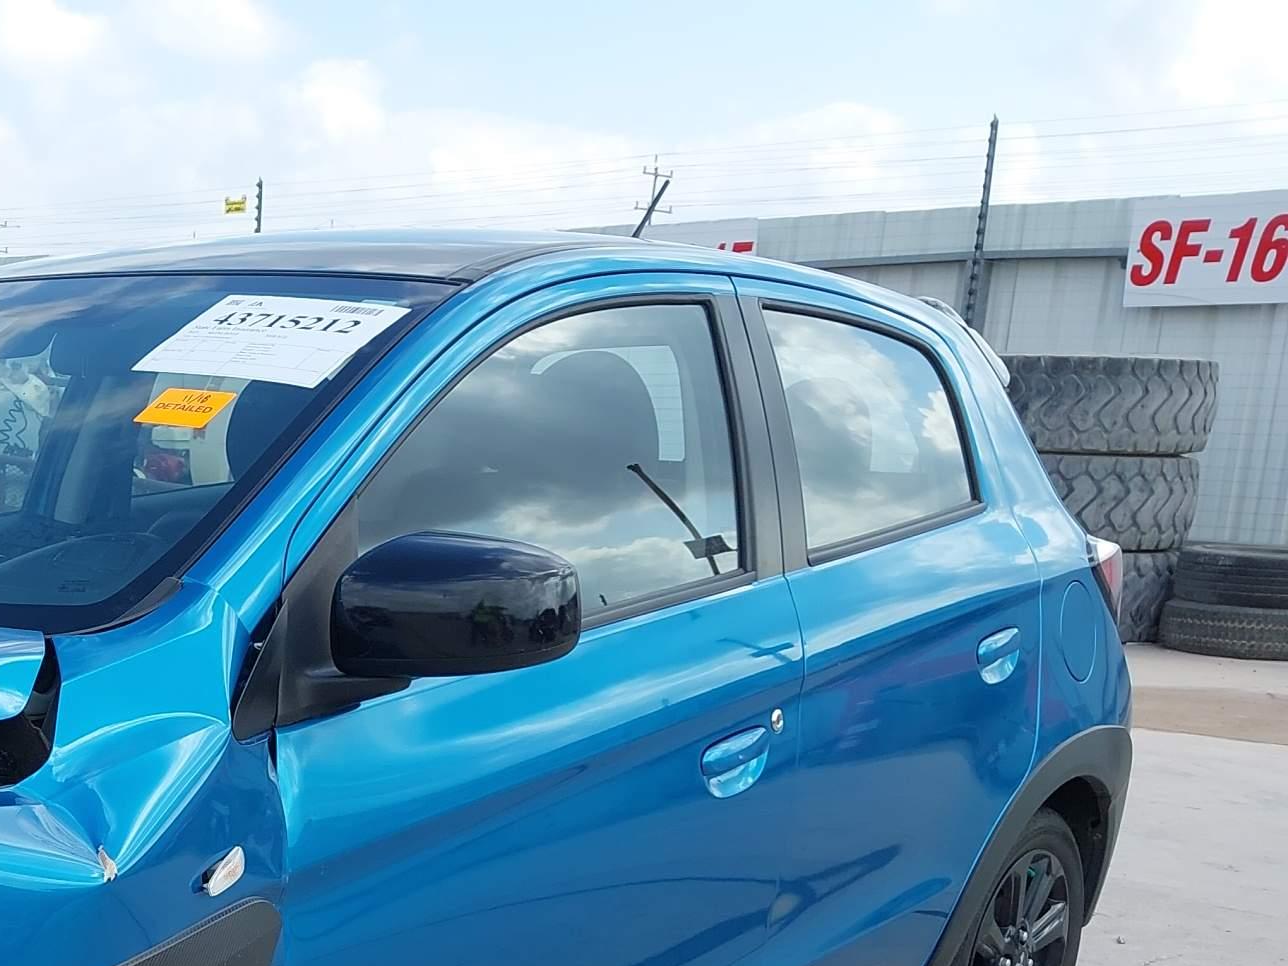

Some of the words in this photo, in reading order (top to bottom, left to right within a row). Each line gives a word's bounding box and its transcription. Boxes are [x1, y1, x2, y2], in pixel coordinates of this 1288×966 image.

[1130, 213, 1288, 286] SF-16
[214, 311, 361, 334] 43715212
[155, 402, 213, 414] DETAILED
